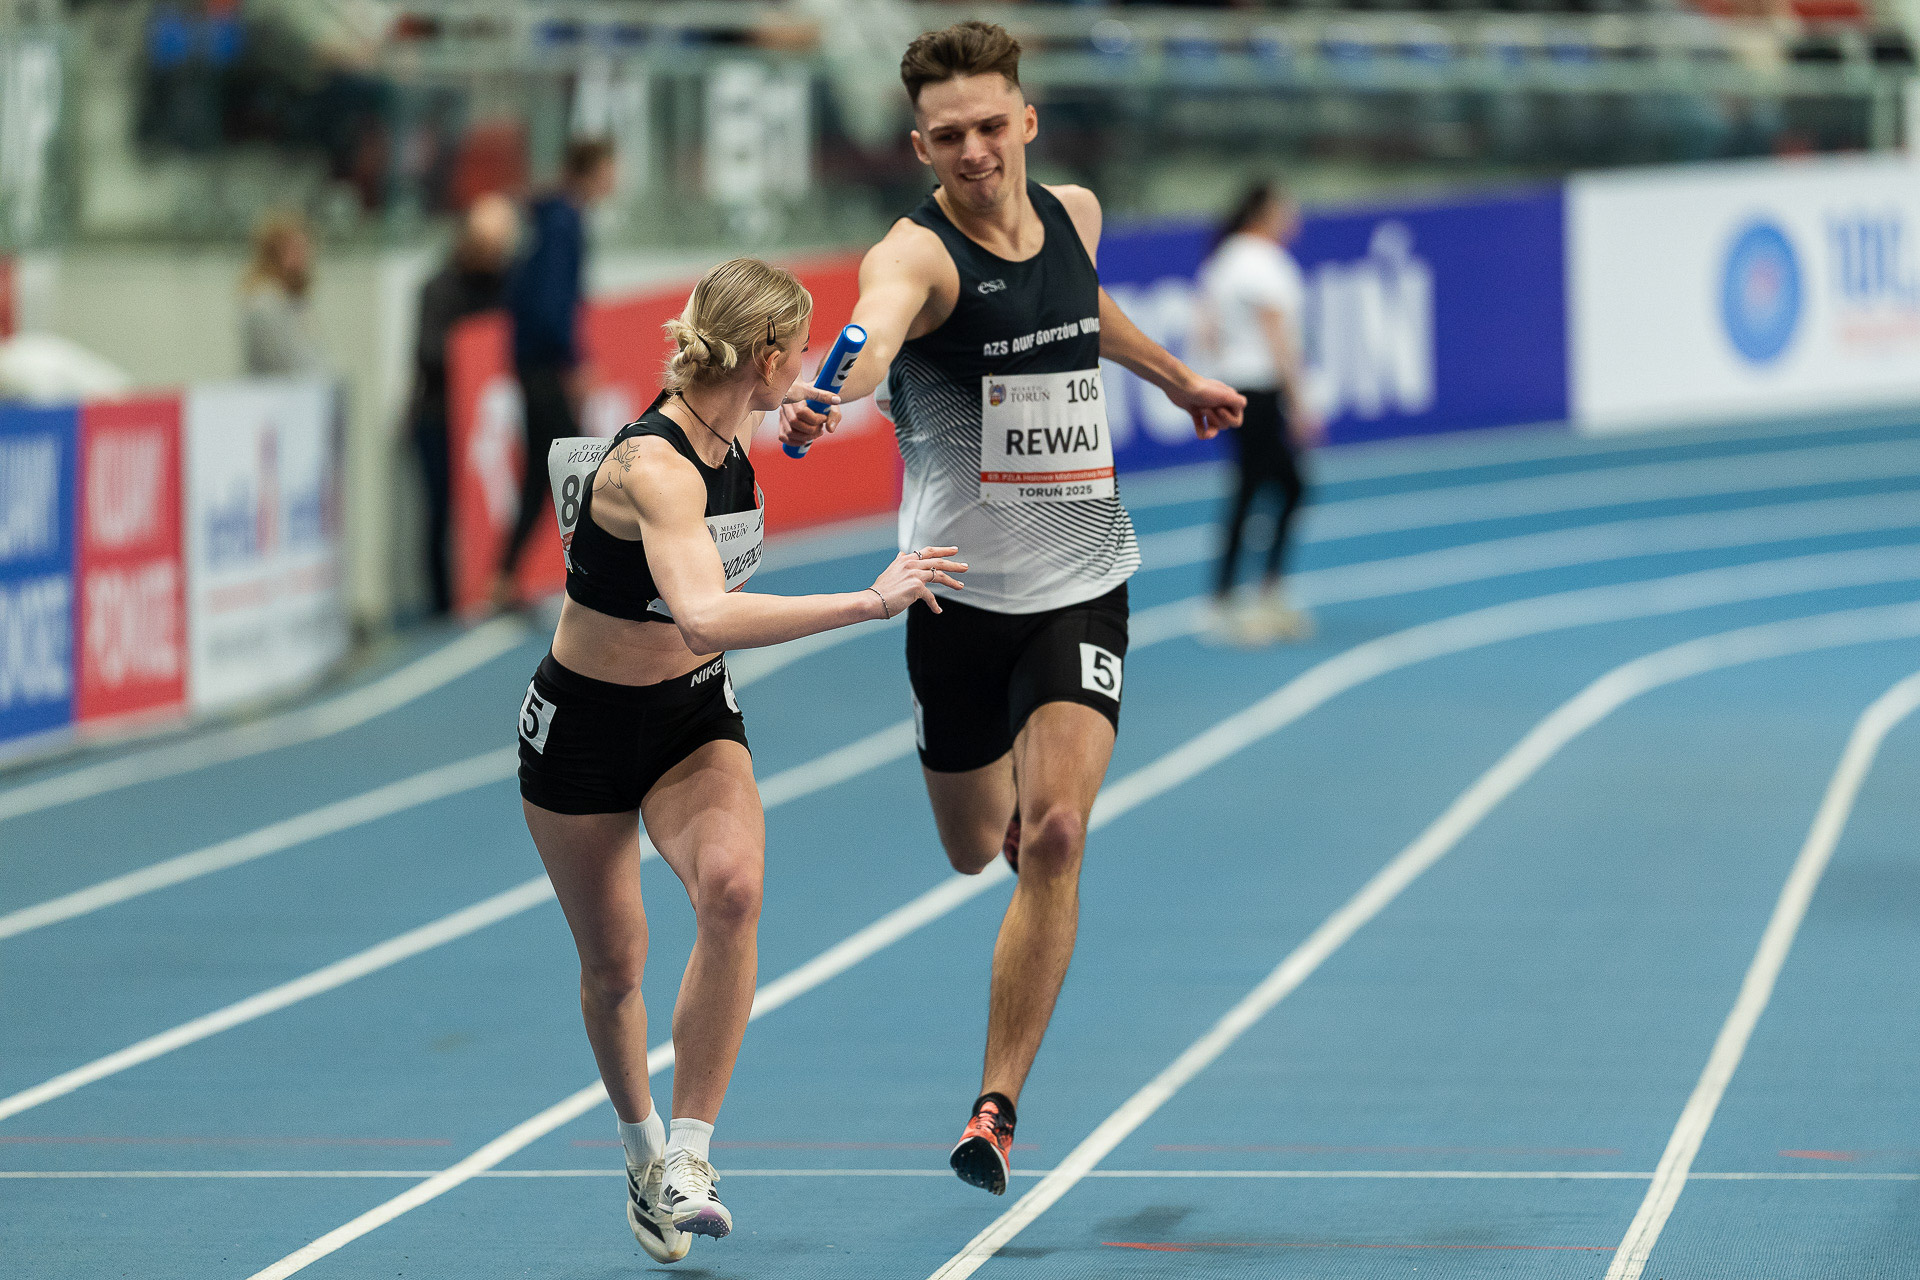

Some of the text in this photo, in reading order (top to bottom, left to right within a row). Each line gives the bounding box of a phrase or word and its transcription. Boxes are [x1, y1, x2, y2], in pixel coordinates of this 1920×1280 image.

[983, 340, 1009, 356] AZS
[1036, 322, 1079, 346] Gorzów
[1066, 377, 1098, 403] 106
[1006, 424, 1099, 456] REWAJ
[1017, 484, 1093, 498] TORUŃ 2025
[719, 525, 749, 543] TORUŃ
[720, 522, 745, 532] MIASTO
[690, 658, 722, 688] NIKE
[1092, 650, 1115, 691] 5
[522, 692, 545, 740] 5
